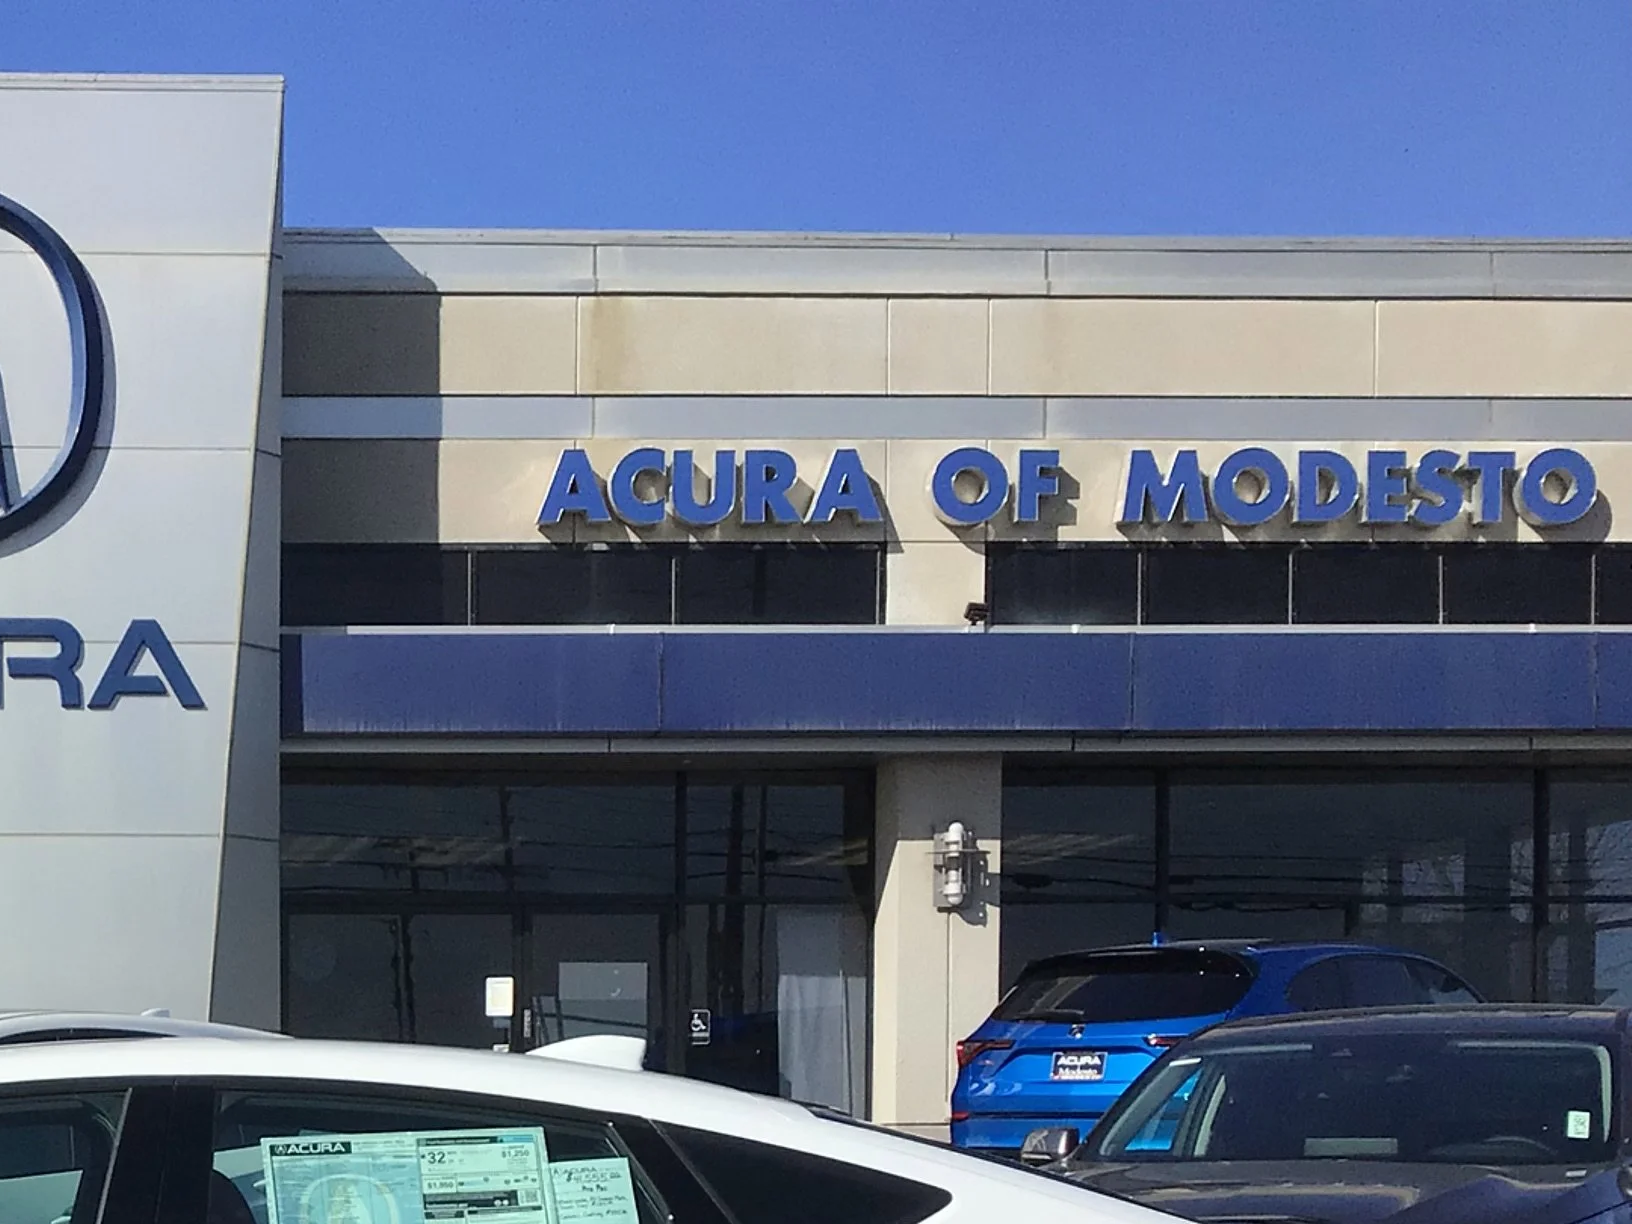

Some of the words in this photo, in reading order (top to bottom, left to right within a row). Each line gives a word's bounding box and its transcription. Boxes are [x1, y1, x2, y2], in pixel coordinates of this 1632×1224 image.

[536, 447, 883, 525] ACURA
[931, 447, 1060, 525] OF
[1116, 447, 1597, 526] MODESTO
[1057, 1055, 1102, 1066] ACURA
[287, 1141, 346, 1155] ACURA
[427, 1151, 447, 1165] 32
